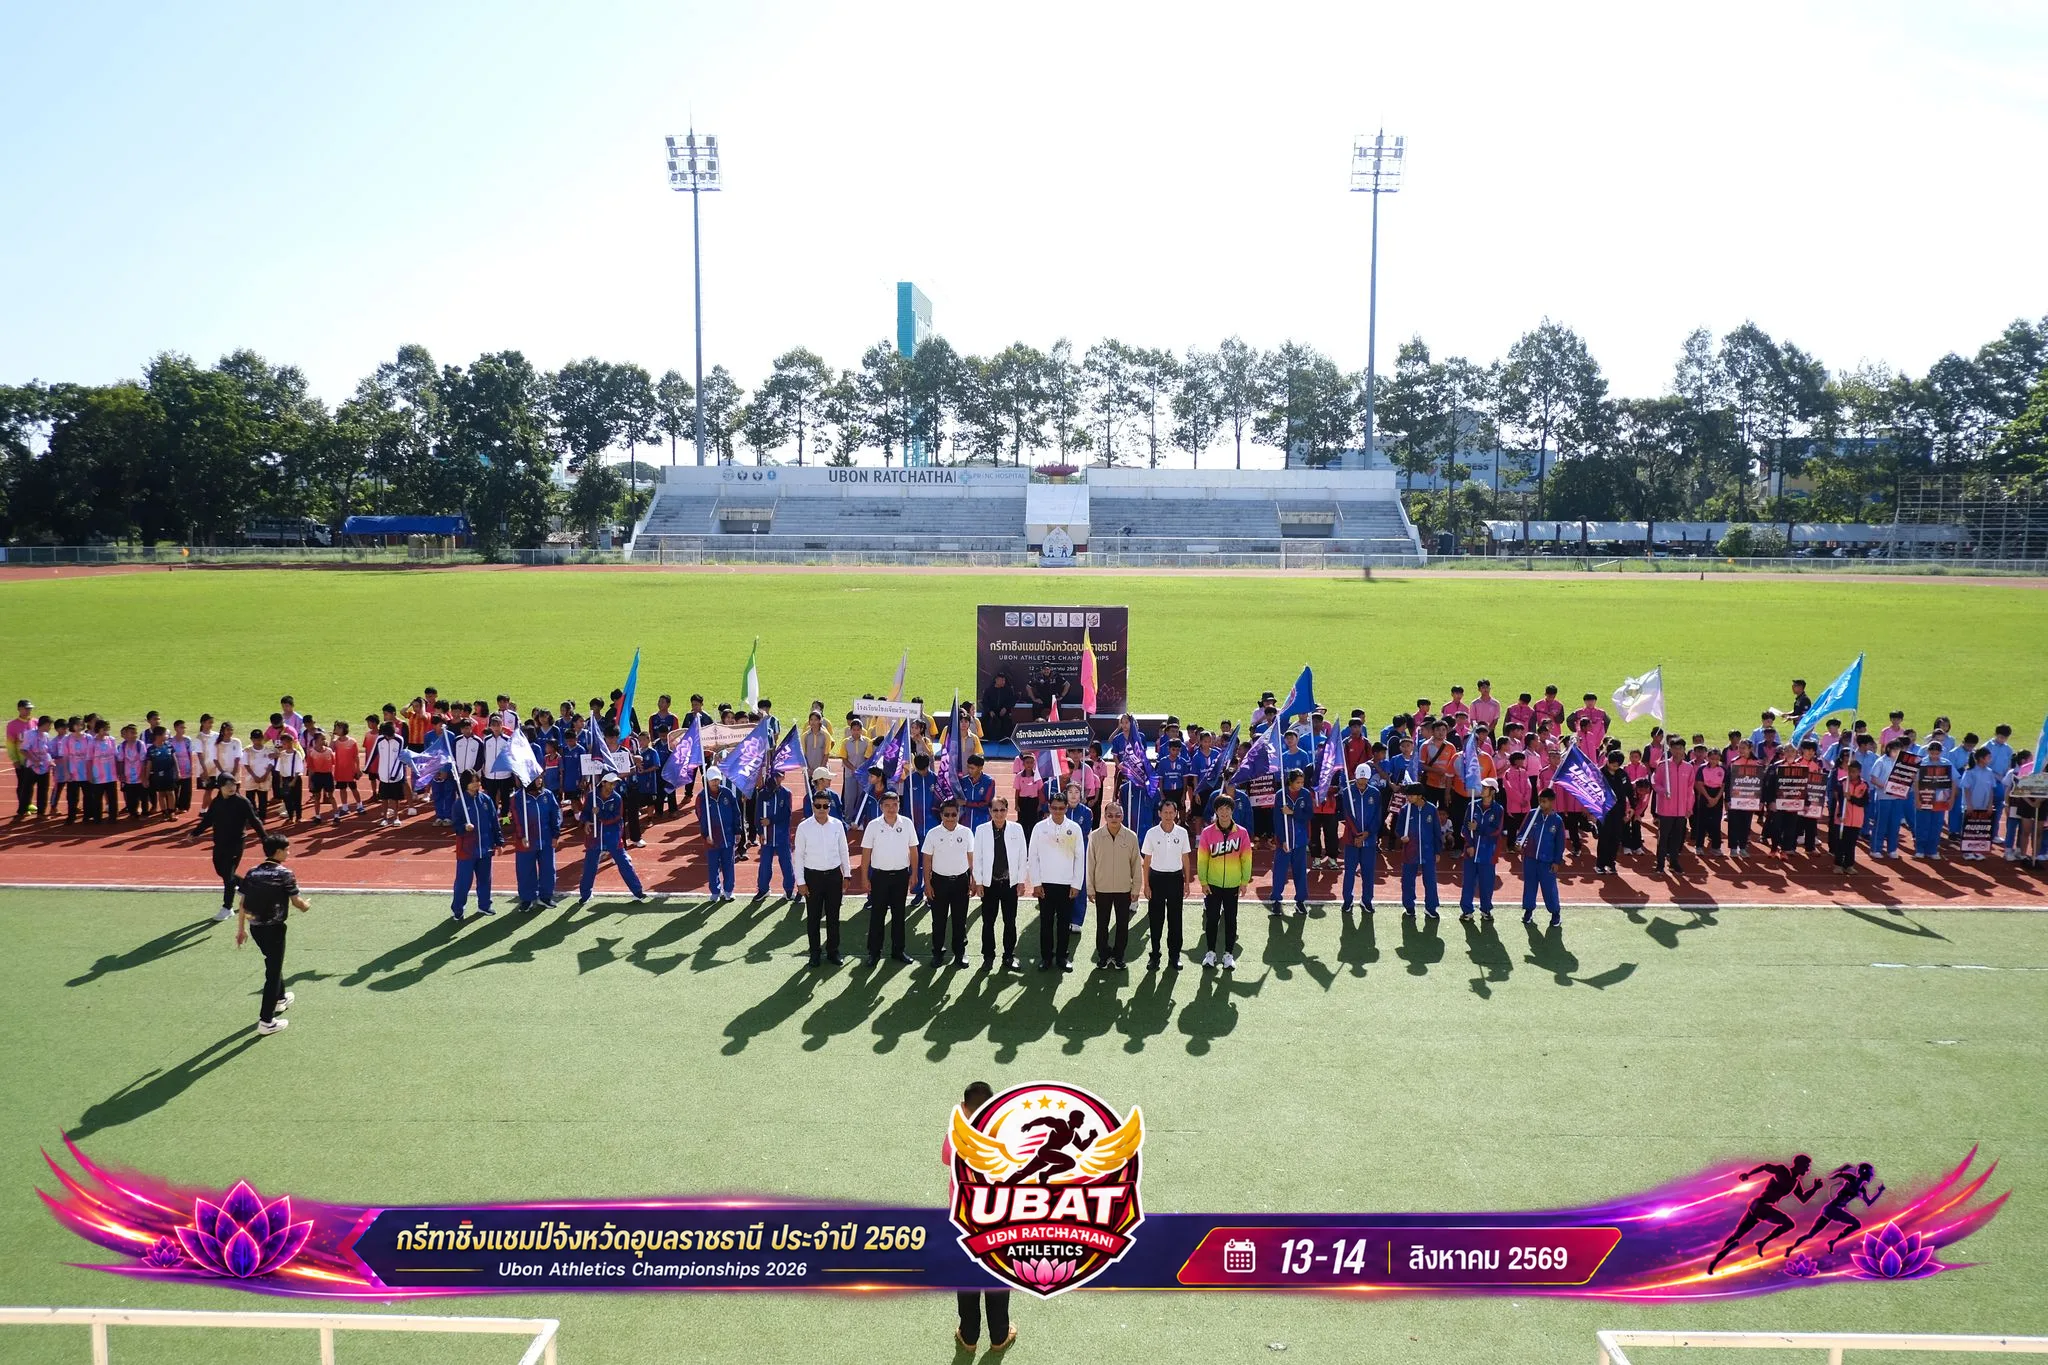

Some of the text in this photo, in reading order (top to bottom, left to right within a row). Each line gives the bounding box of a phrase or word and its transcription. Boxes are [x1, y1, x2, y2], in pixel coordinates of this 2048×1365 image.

[829, 470, 956, 483] UBON RATCHATHA
[1568, 763, 1606, 804] UBON
